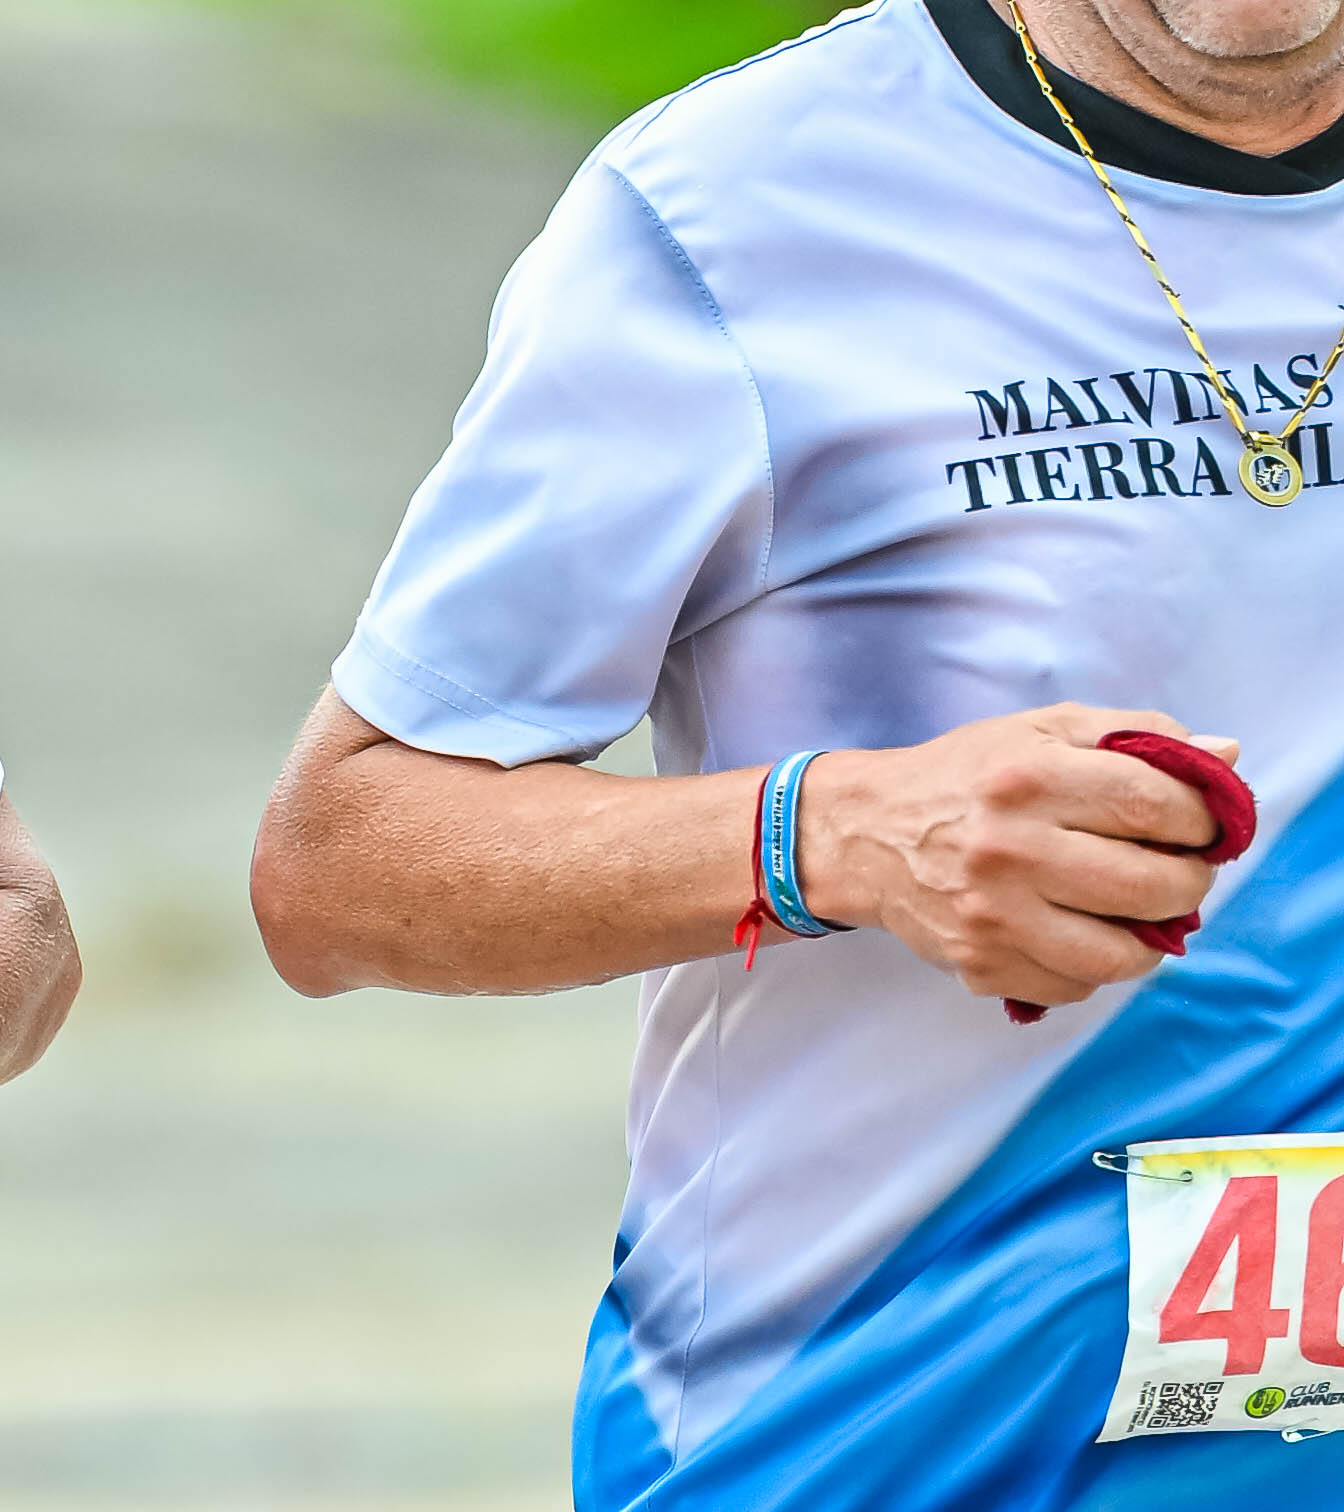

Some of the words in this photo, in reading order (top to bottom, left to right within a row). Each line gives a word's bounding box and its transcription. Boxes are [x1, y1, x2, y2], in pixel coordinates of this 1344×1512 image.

[964, 352, 1334, 441] MALVINAS
[945, 435, 1233, 513] TIERRA
[1290, 1381, 1331, 1397] CLUB
